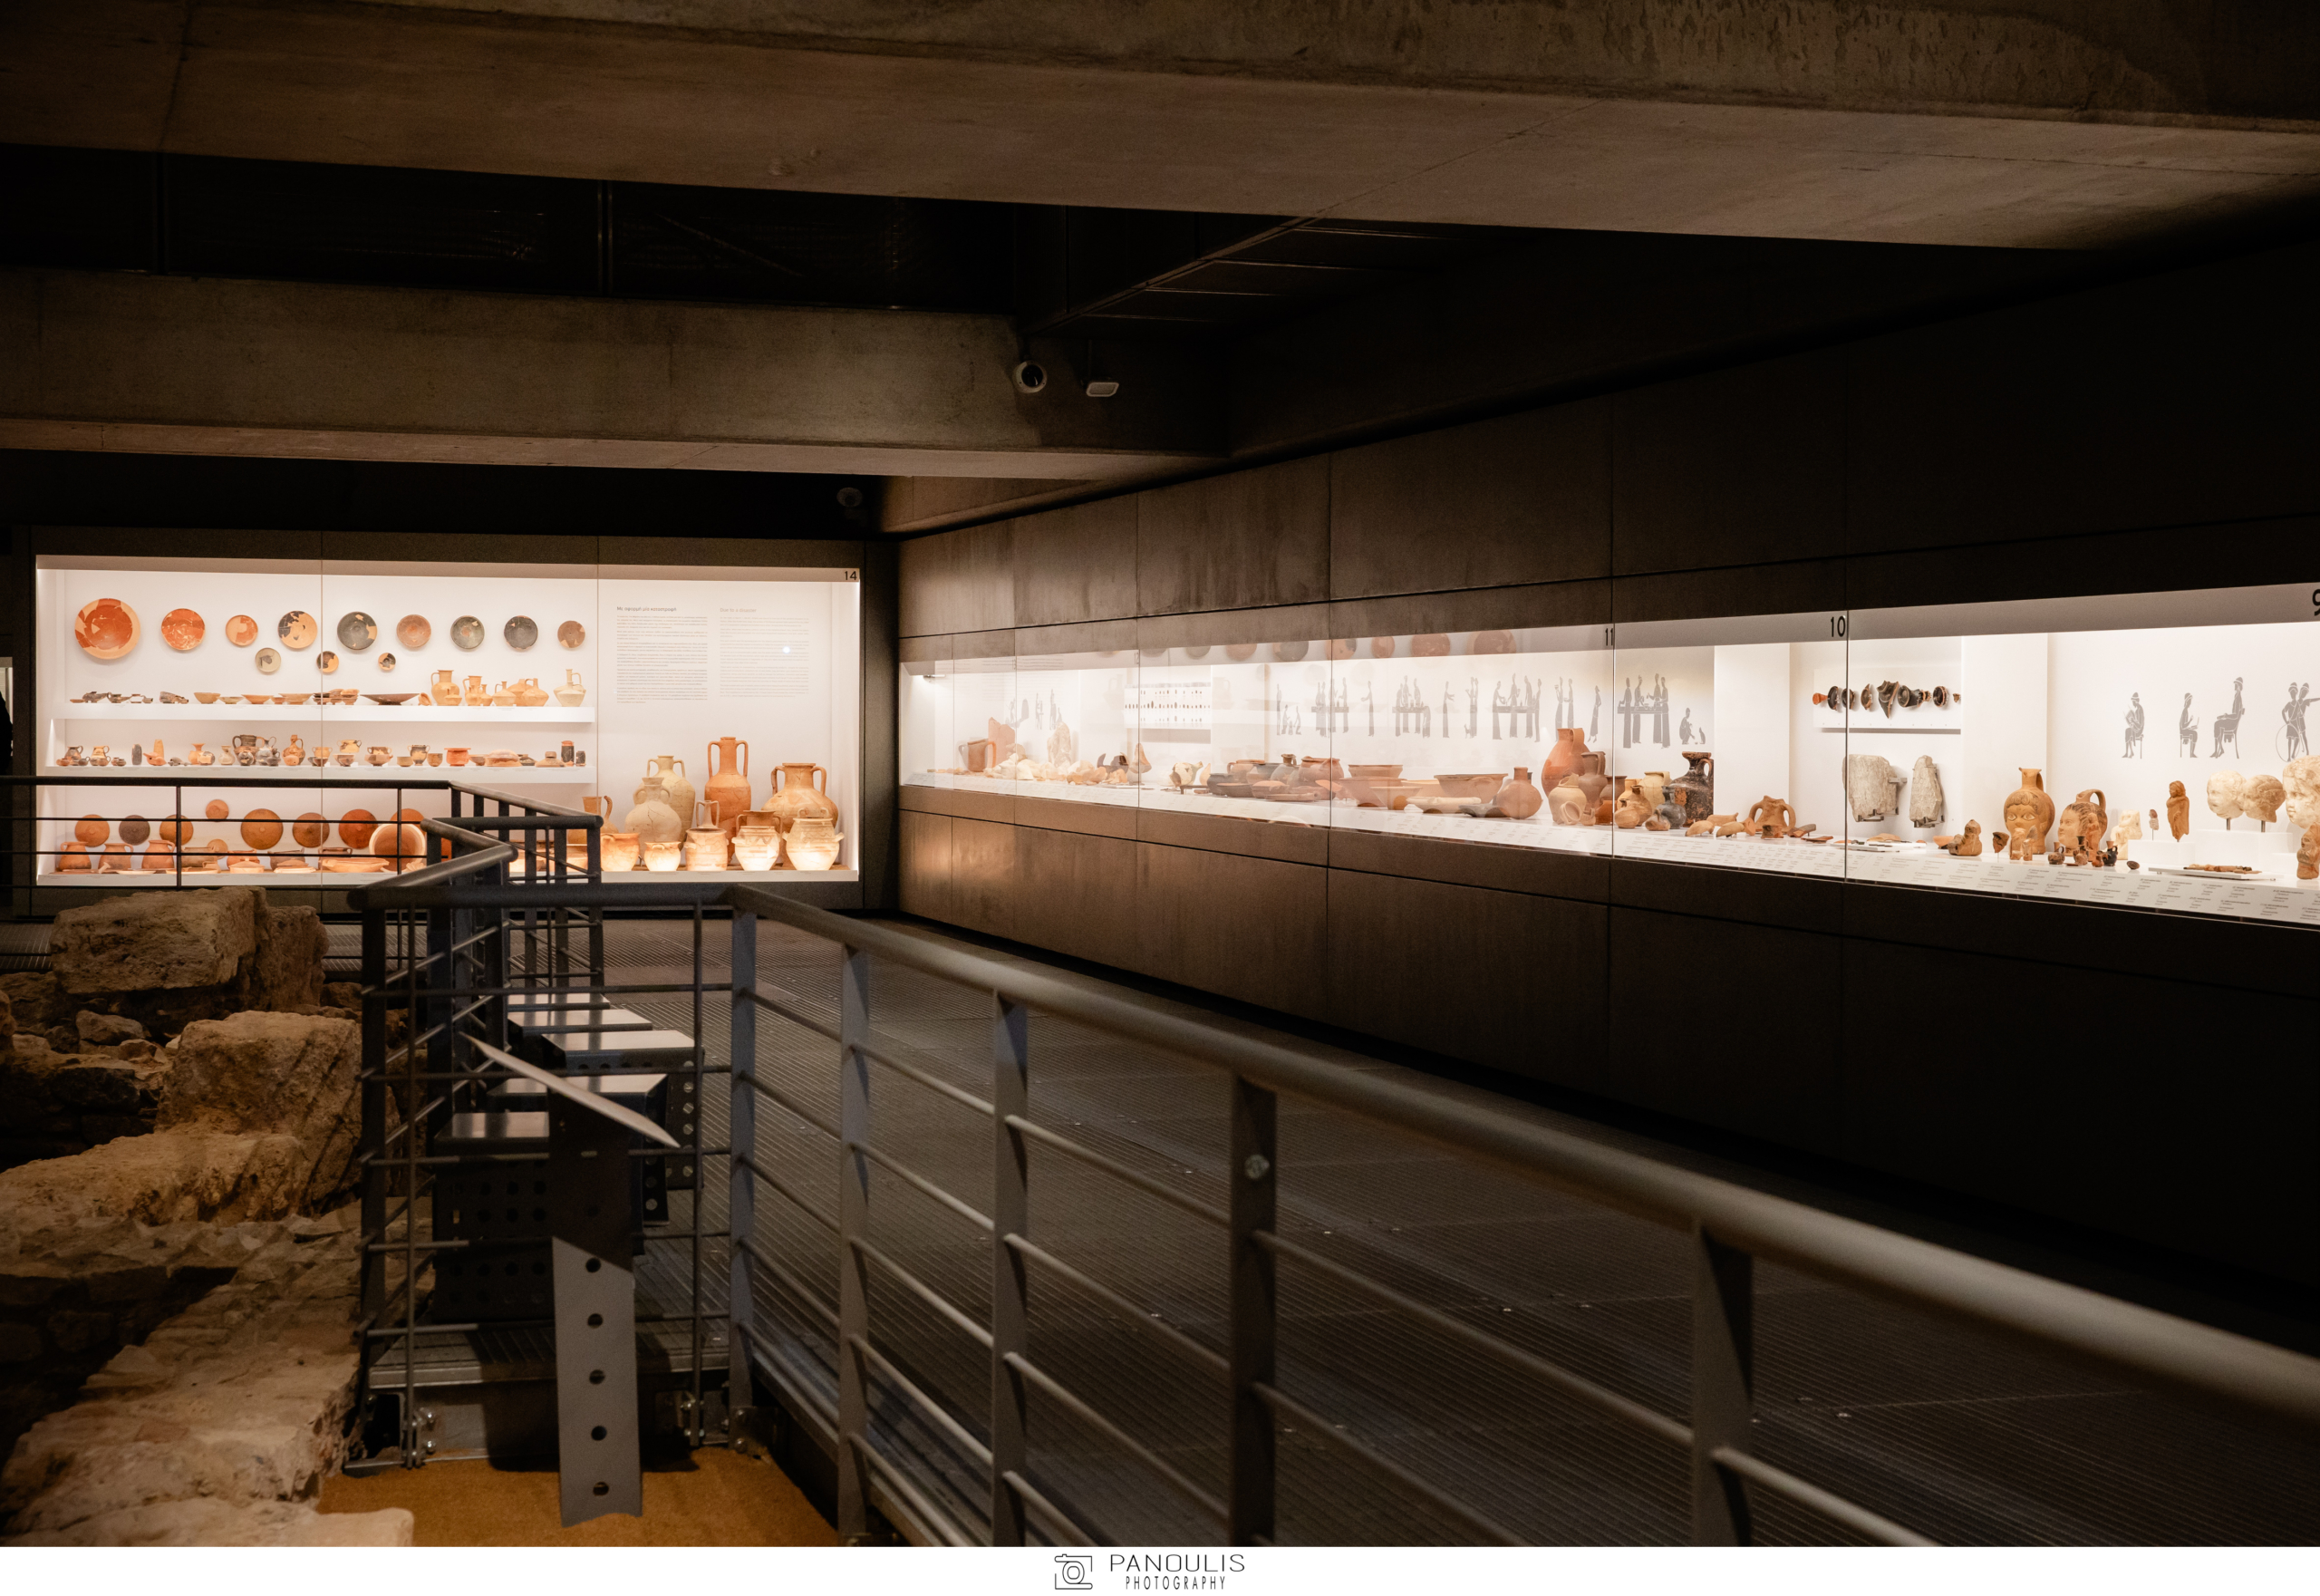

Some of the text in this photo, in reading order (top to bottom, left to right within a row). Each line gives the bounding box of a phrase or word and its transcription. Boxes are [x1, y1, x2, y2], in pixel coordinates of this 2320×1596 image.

[845, 570, 857, 581] 14
[2312, 588, 2320, 616] 9
[1605, 627, 1613, 646] 11
[1830, 615, 1846, 638] 10
